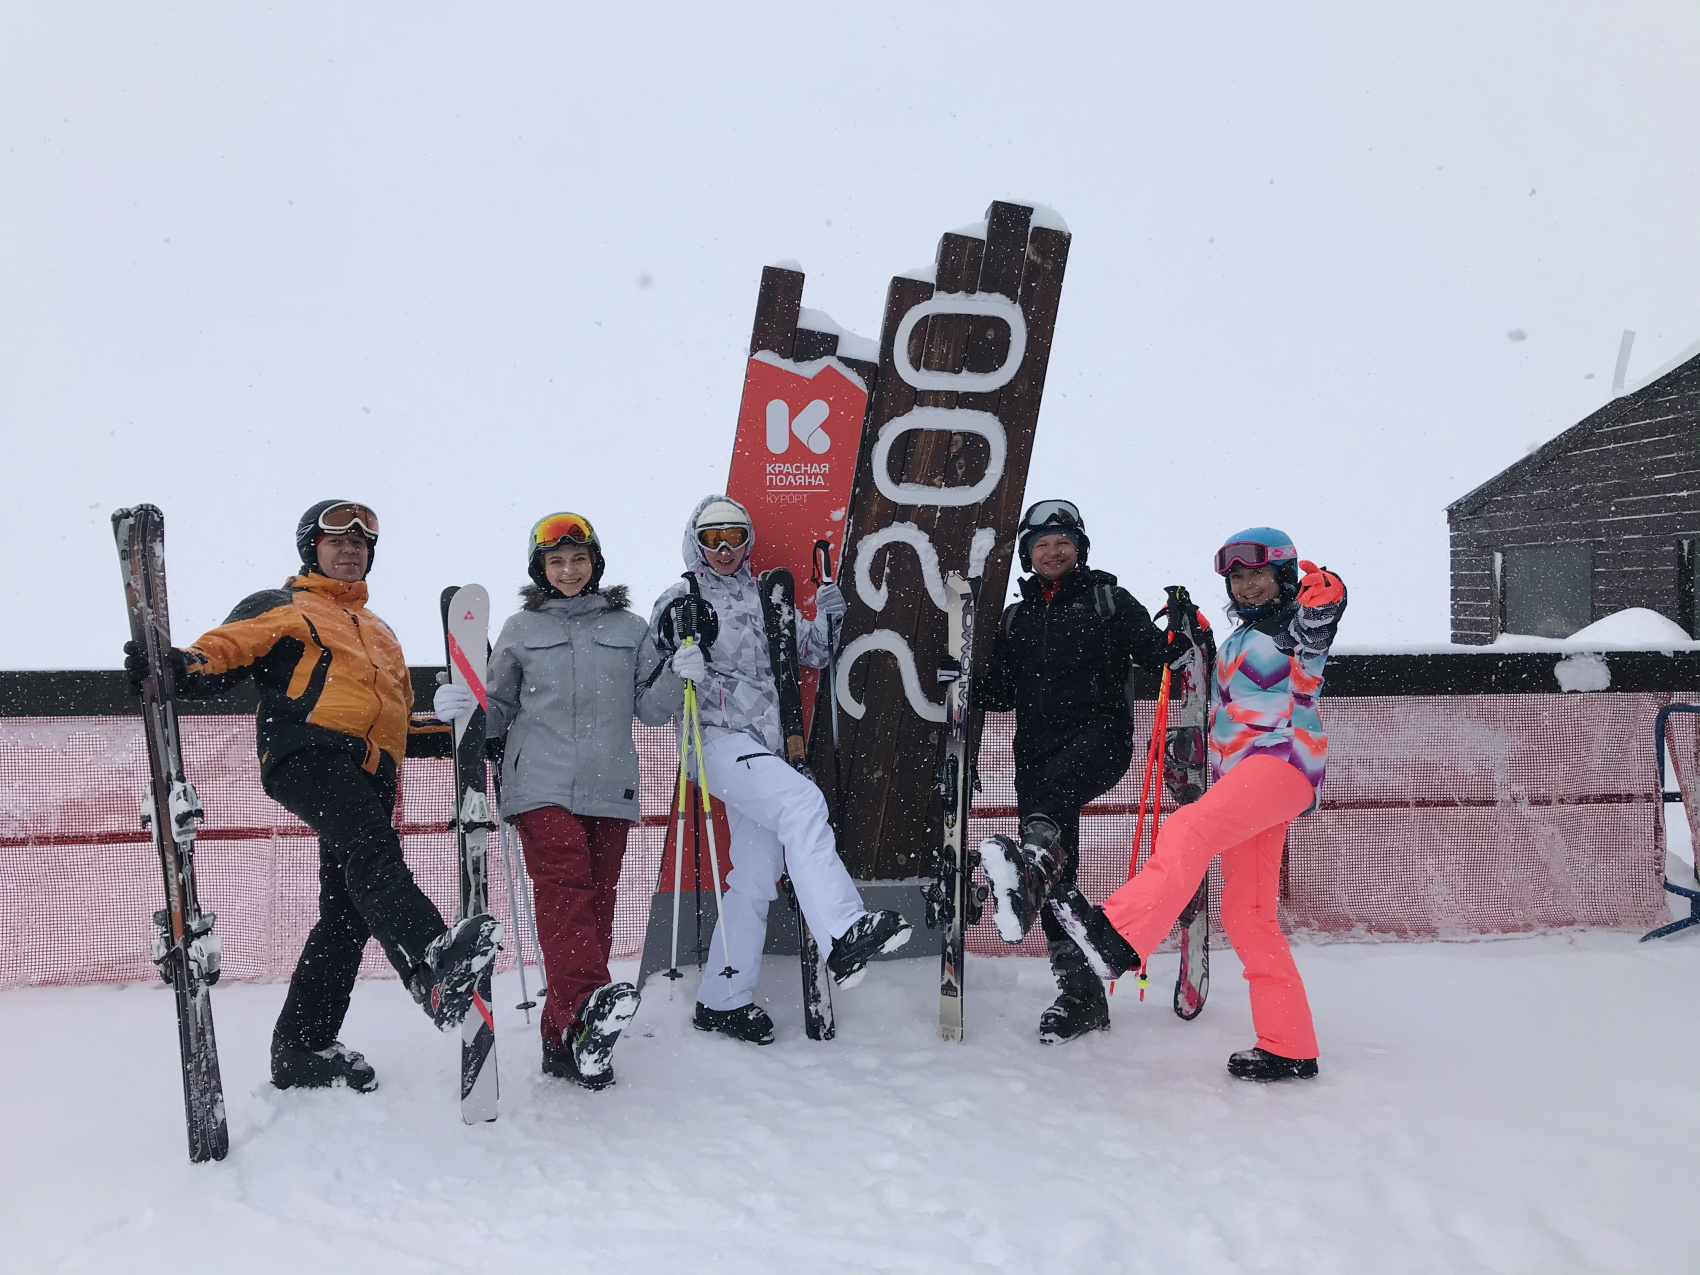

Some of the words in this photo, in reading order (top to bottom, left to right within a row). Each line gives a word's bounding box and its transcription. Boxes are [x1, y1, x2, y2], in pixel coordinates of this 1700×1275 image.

[766, 463, 829, 474] КРАСНАЯ
[766, 475, 824, 486] ПОЛЯНА
[766, 494, 808, 504] КУРОРТ
[836, 293, 1027, 722] 2200
[166, 852, 180, 913] ATOMIC
[850, 934, 874, 951] ATOMIC
